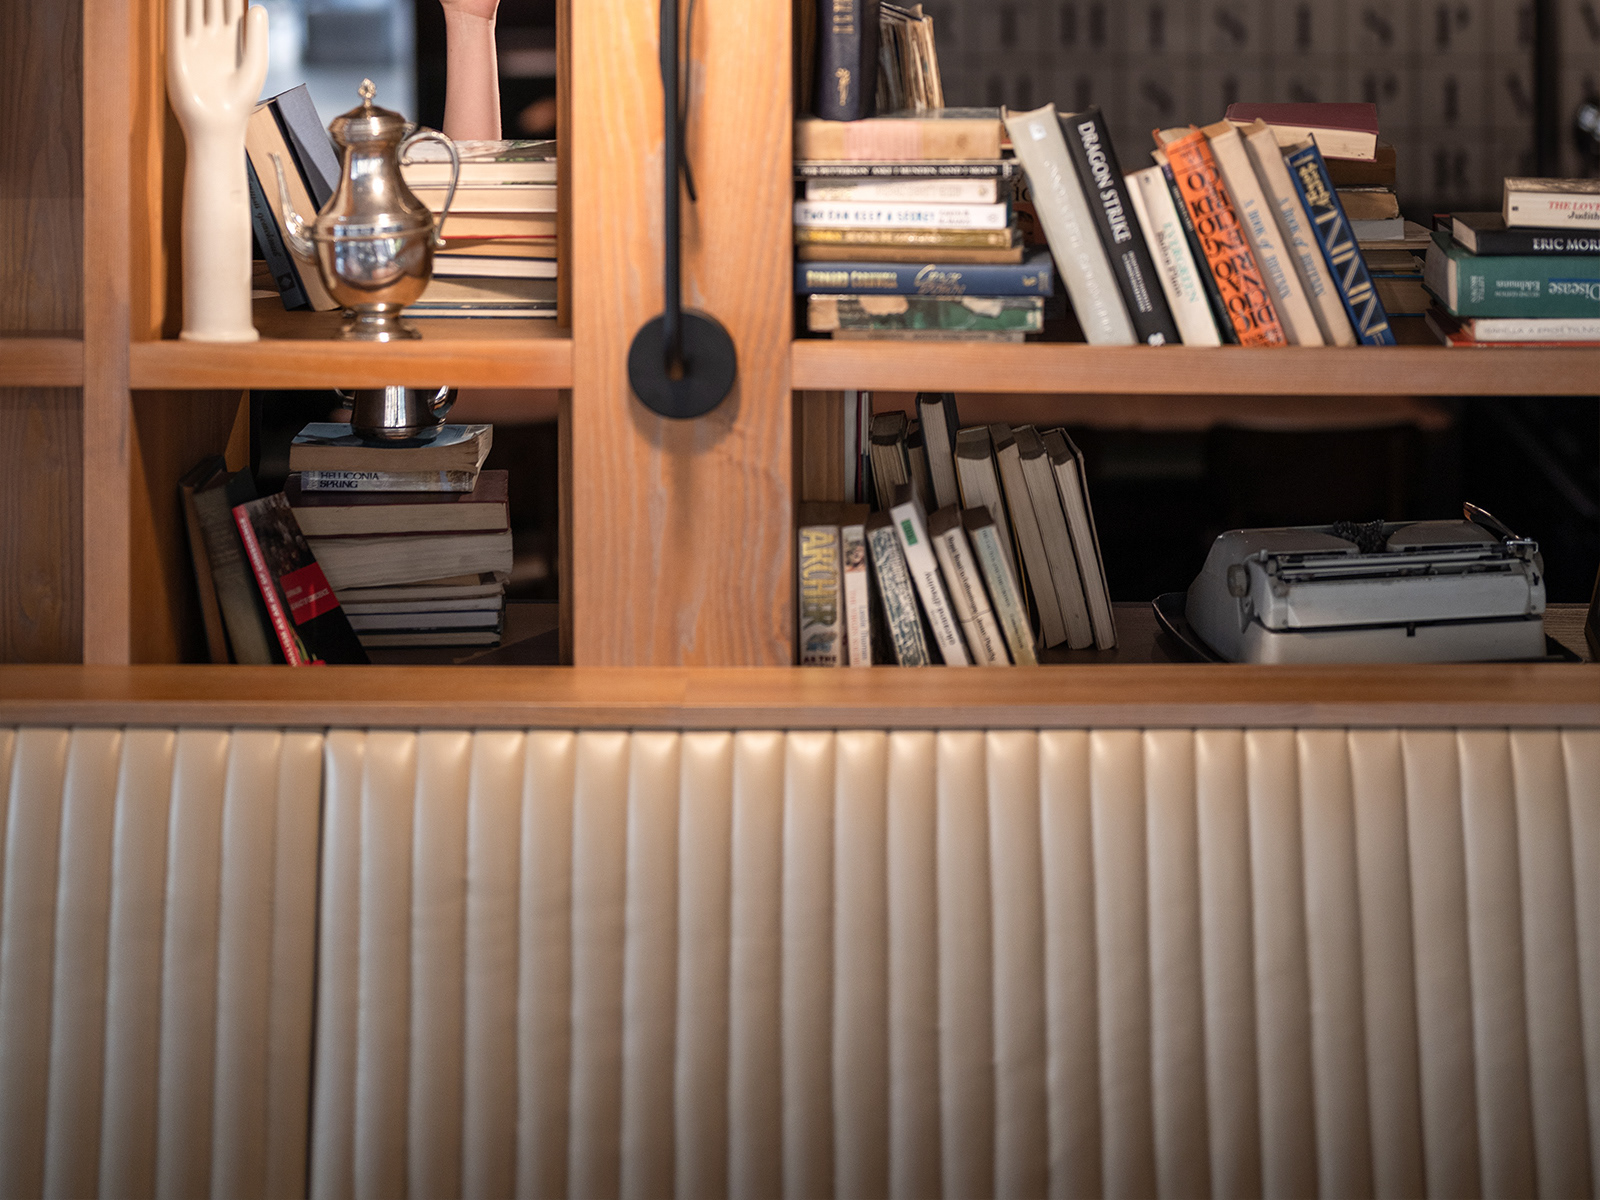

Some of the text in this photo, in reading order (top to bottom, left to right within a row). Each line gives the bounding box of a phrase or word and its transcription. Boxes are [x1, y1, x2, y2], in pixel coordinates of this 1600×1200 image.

[1075, 119, 1116, 190] DRAGON
[1097, 187, 1133, 244] STRIKE
[1548, 200, 1568, 209] THE
[898, 210, 934, 221] SECRET
[1247, 208, 1267, 237] BOOK
[1281, 207, 1301, 235] BOOK
[1567, 210, 1600, 220] Judith
[1532, 237, 1563, 250] ERIC
[1161, 221, 1200, 303] EVERGREEN
[806, 270, 897, 288] BERNARD CORNWELL
[1495, 280, 1540, 290] Edelmann
[1548, 282, 1600, 301] Disease
[319, 480, 358, 488] SPRING
[238, 518, 264, 571] CONSCIENCE
[258, 572, 267, 585] OF
[800, 528, 838, 631] ARCHER
[263, 584, 274, 603] ACT
[270, 604, 278, 616] AN
[275, 617, 284, 631] AS
